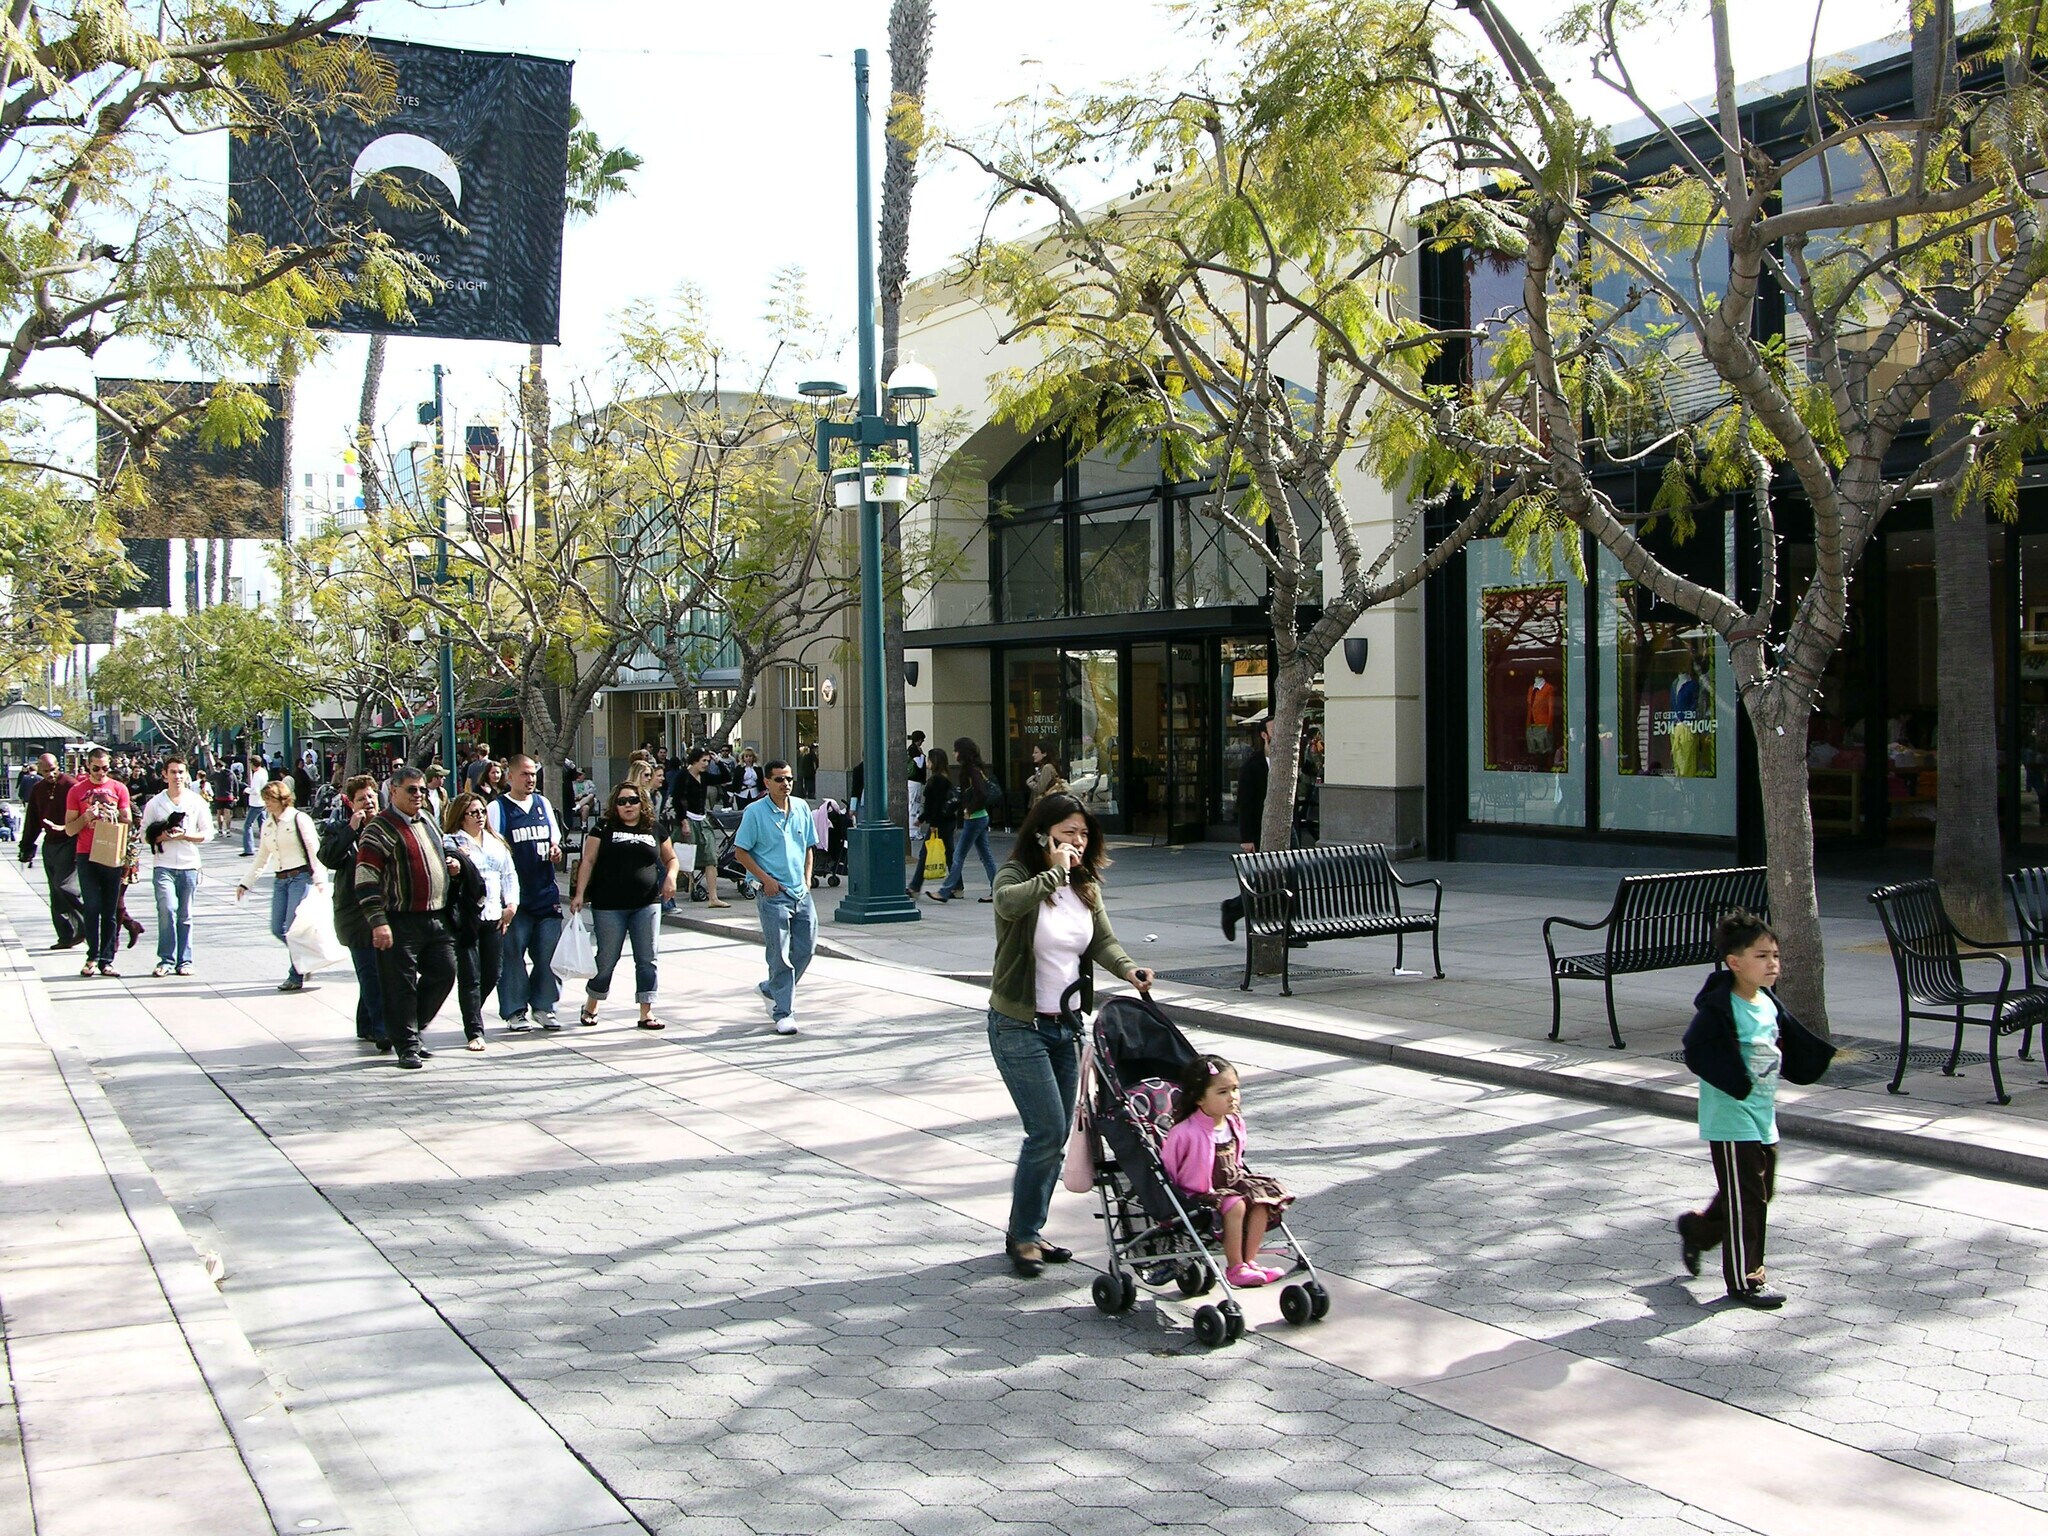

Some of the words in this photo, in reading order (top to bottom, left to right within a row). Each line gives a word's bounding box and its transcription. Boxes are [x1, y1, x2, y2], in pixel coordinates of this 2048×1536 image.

[395, 95, 420, 107] EYES
[457, 281, 488, 291] LIGHT
[1034, 715, 1054, 723] DEFINE
[1024, 725, 1040, 734] YOUR
[1040, 725, 1058, 734] STYLE
[511, 825, 549, 843] DALLAS
[536, 842, 550, 861] 41
